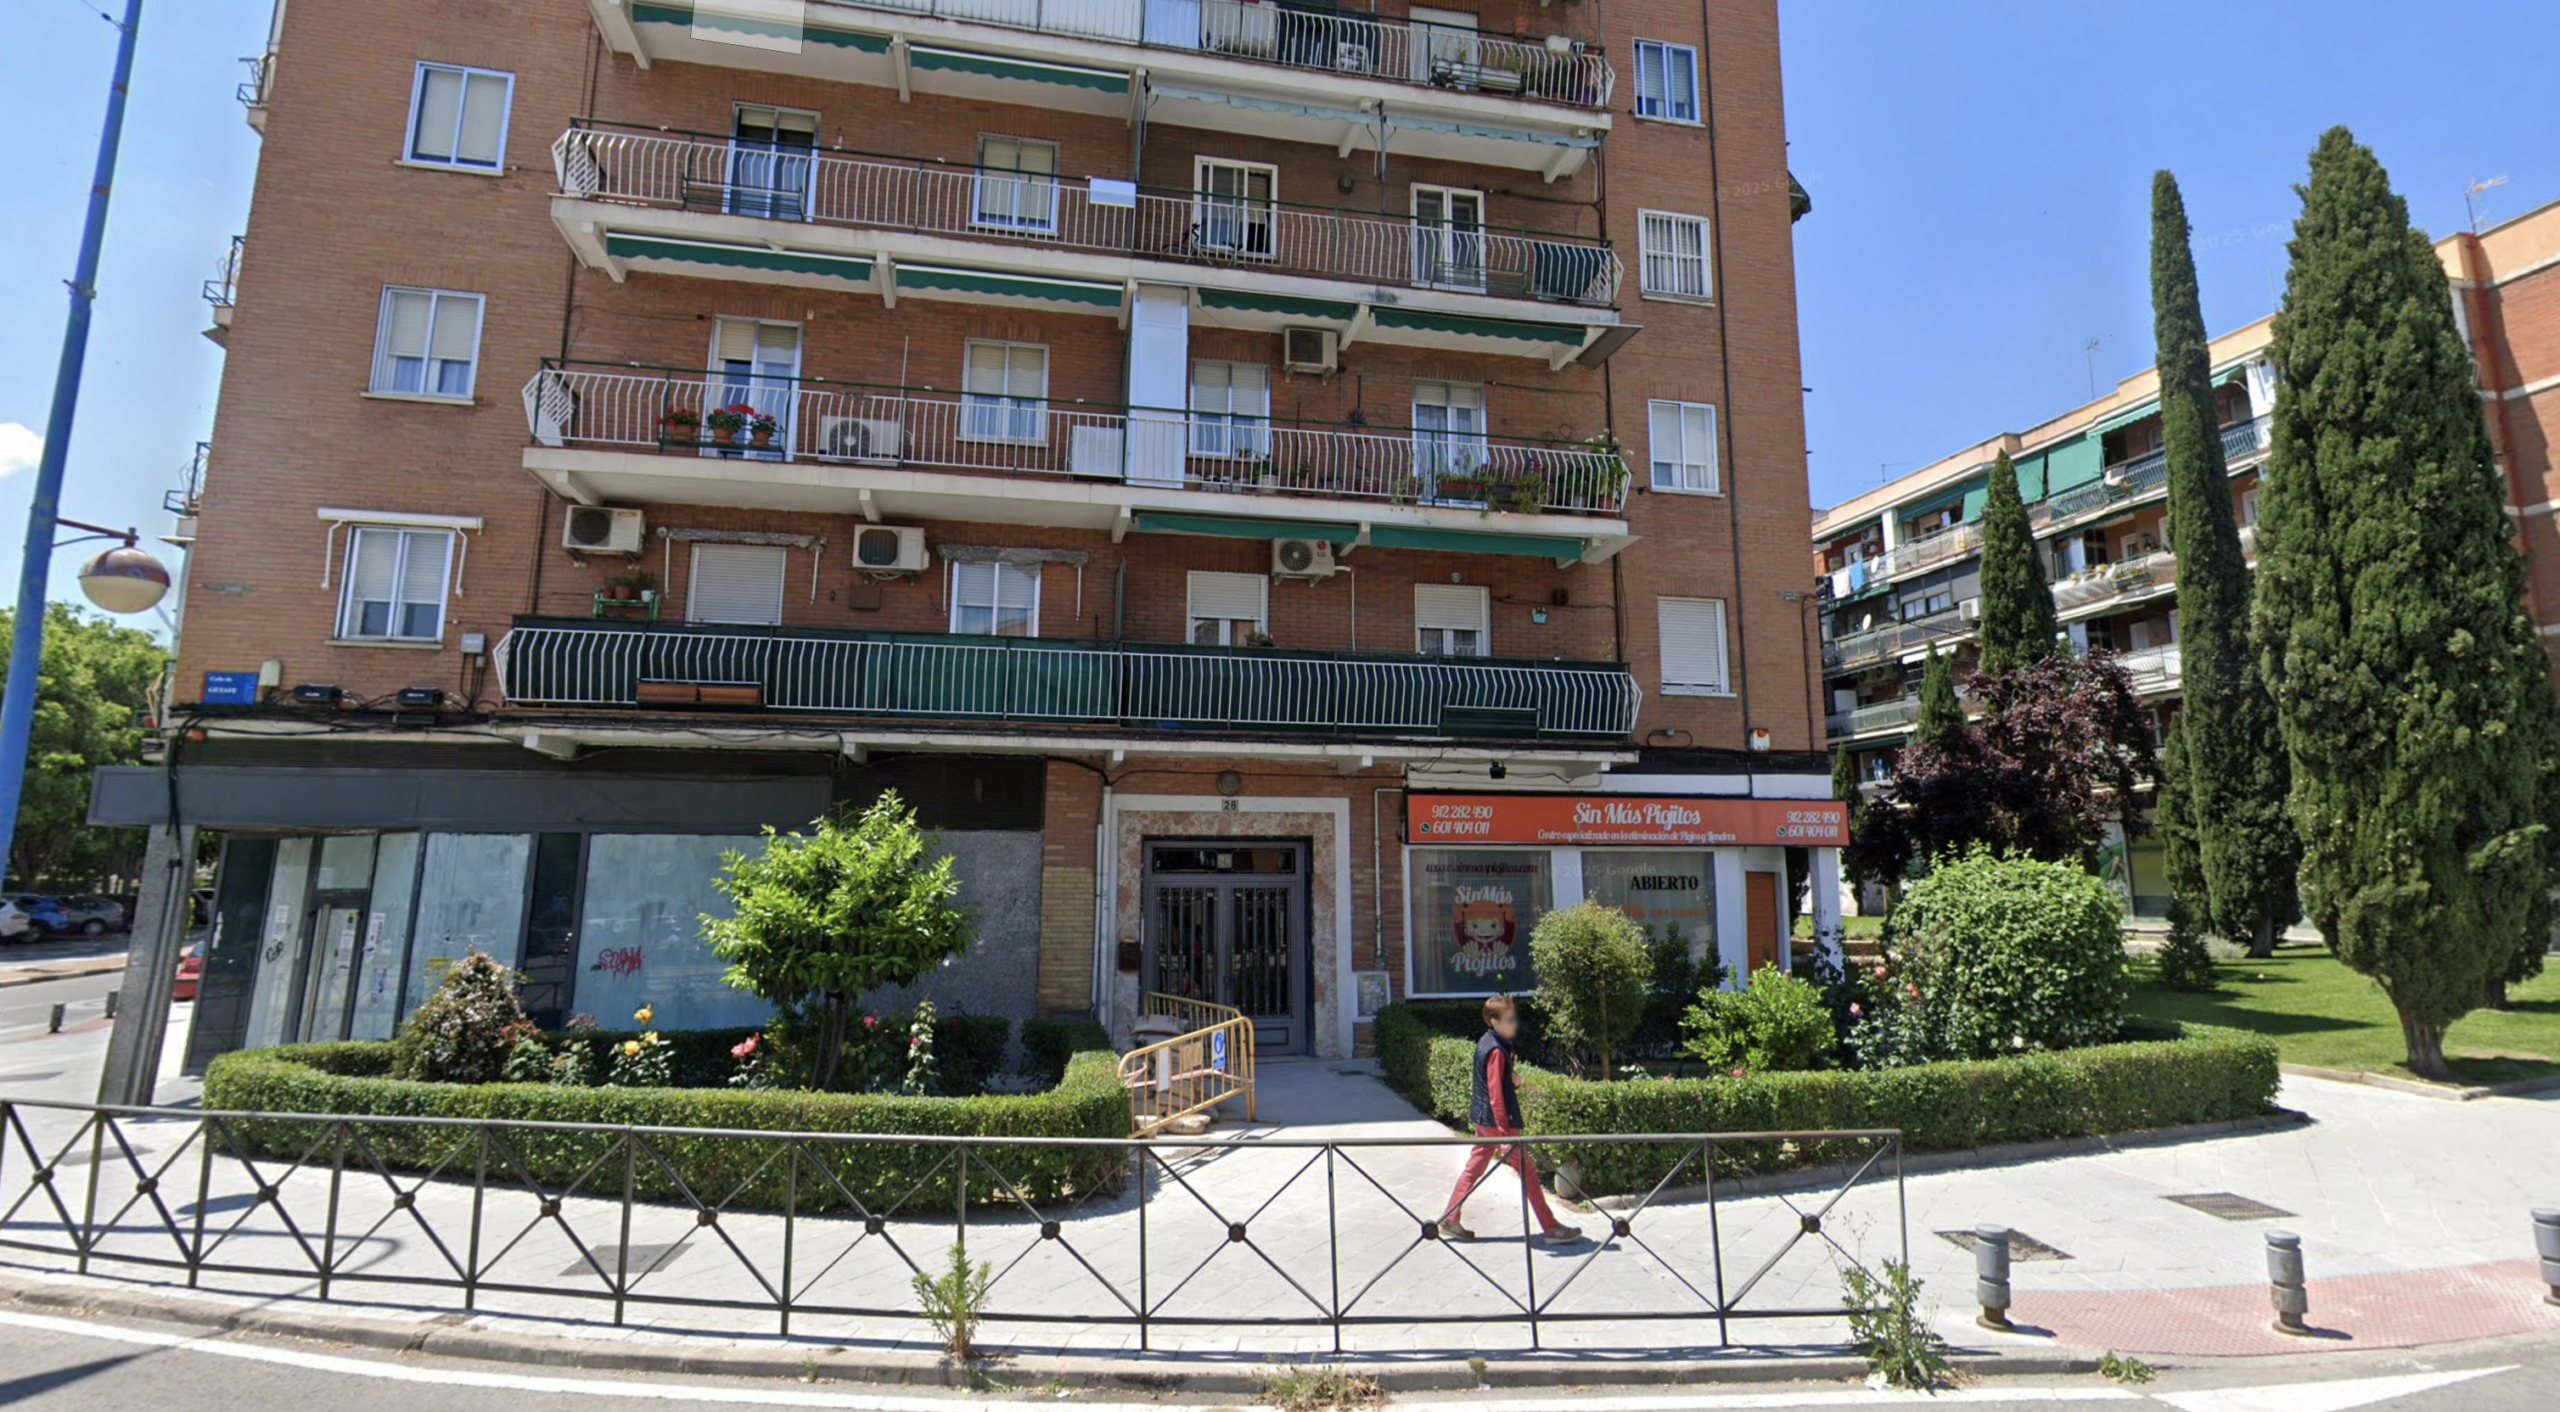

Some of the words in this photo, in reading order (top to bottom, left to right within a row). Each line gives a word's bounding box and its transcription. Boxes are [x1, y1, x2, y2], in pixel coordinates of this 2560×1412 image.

[1223, 801, 1237, 810] 28
[1432, 805, 1449, 819] 912
[1450, 805, 1471, 819] 282
[1472, 806, 1493, 819] 490
[1573, 802, 1601, 824] Sin
[1604, 803, 1641, 824] Más
[1643, 804, 1701, 831] Piojitos
[1786, 811, 1802, 823] 912
[1803, 811, 1821, 823] 282
[1821, 811, 1840, 824] 490
[1433, 821, 1450, 834] 601
[1454, 821, 1474, 834] 404
[1475, 821, 1490, 834] 011
[1788, 825, 1805, 837] 601
[1806, 825, 1823, 837] 404
[1824, 825, 1838, 837] 011
[1630, 875, 1699, 890] ABIERTO
[1451, 952, 1516, 977] Piojitos
